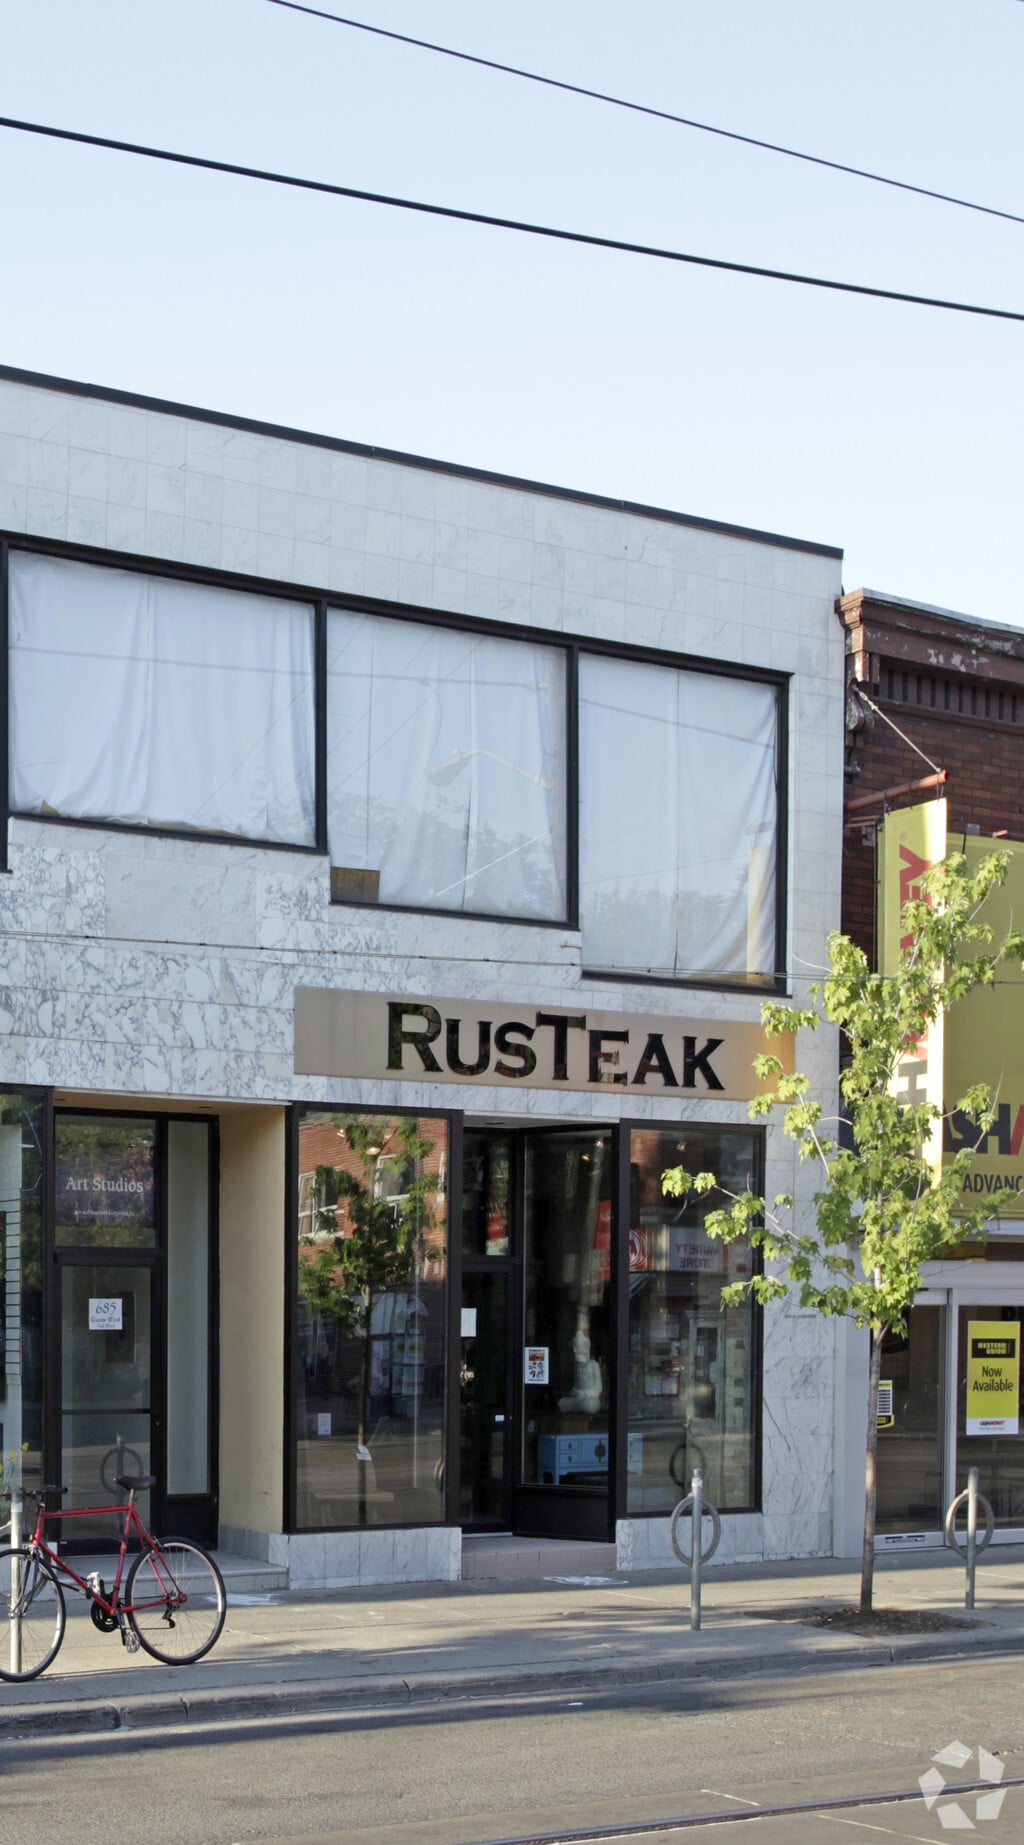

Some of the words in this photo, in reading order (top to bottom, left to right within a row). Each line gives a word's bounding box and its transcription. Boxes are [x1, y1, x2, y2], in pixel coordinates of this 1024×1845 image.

[65, 1177, 88, 1191] Art
[92, 1178, 144, 1193] Studios
[982, 1366, 1002, 1377] Now
[973, 1379, 1013, 1392] Available
